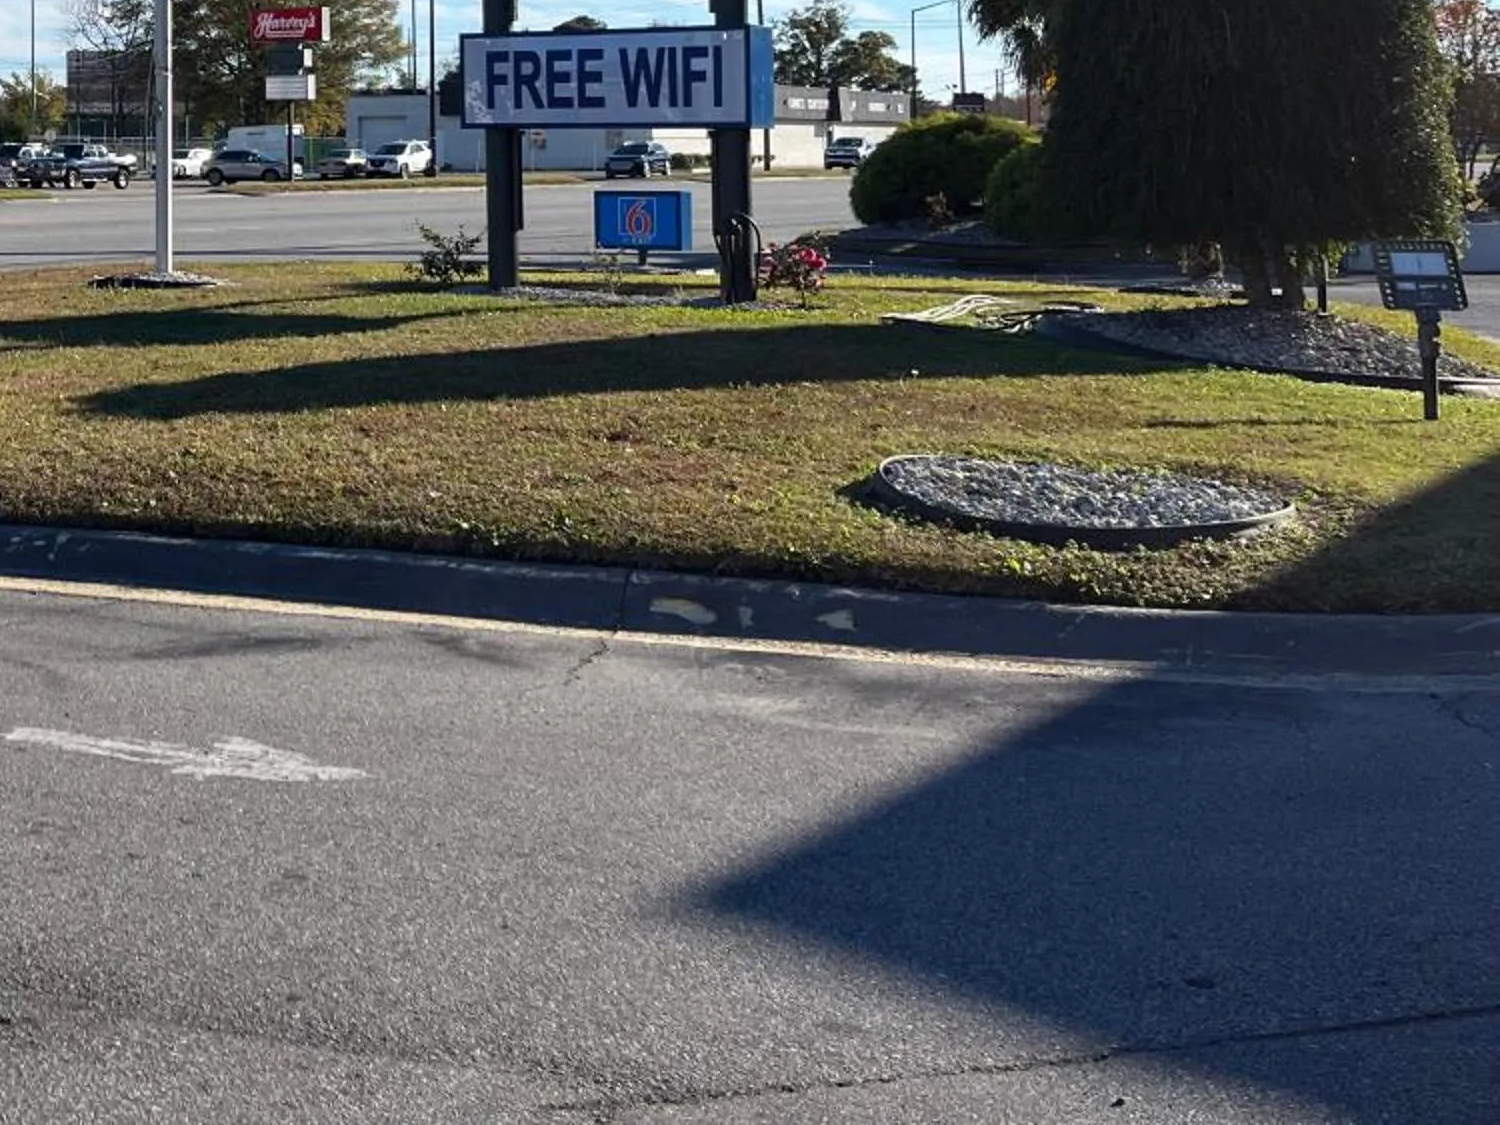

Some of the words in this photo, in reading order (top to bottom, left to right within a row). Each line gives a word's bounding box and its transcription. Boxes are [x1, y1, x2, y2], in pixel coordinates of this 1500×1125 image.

[486, 48, 605, 110] FREE
[619, 45, 723, 109] WIFI
[626, 200, 651, 236] 6
